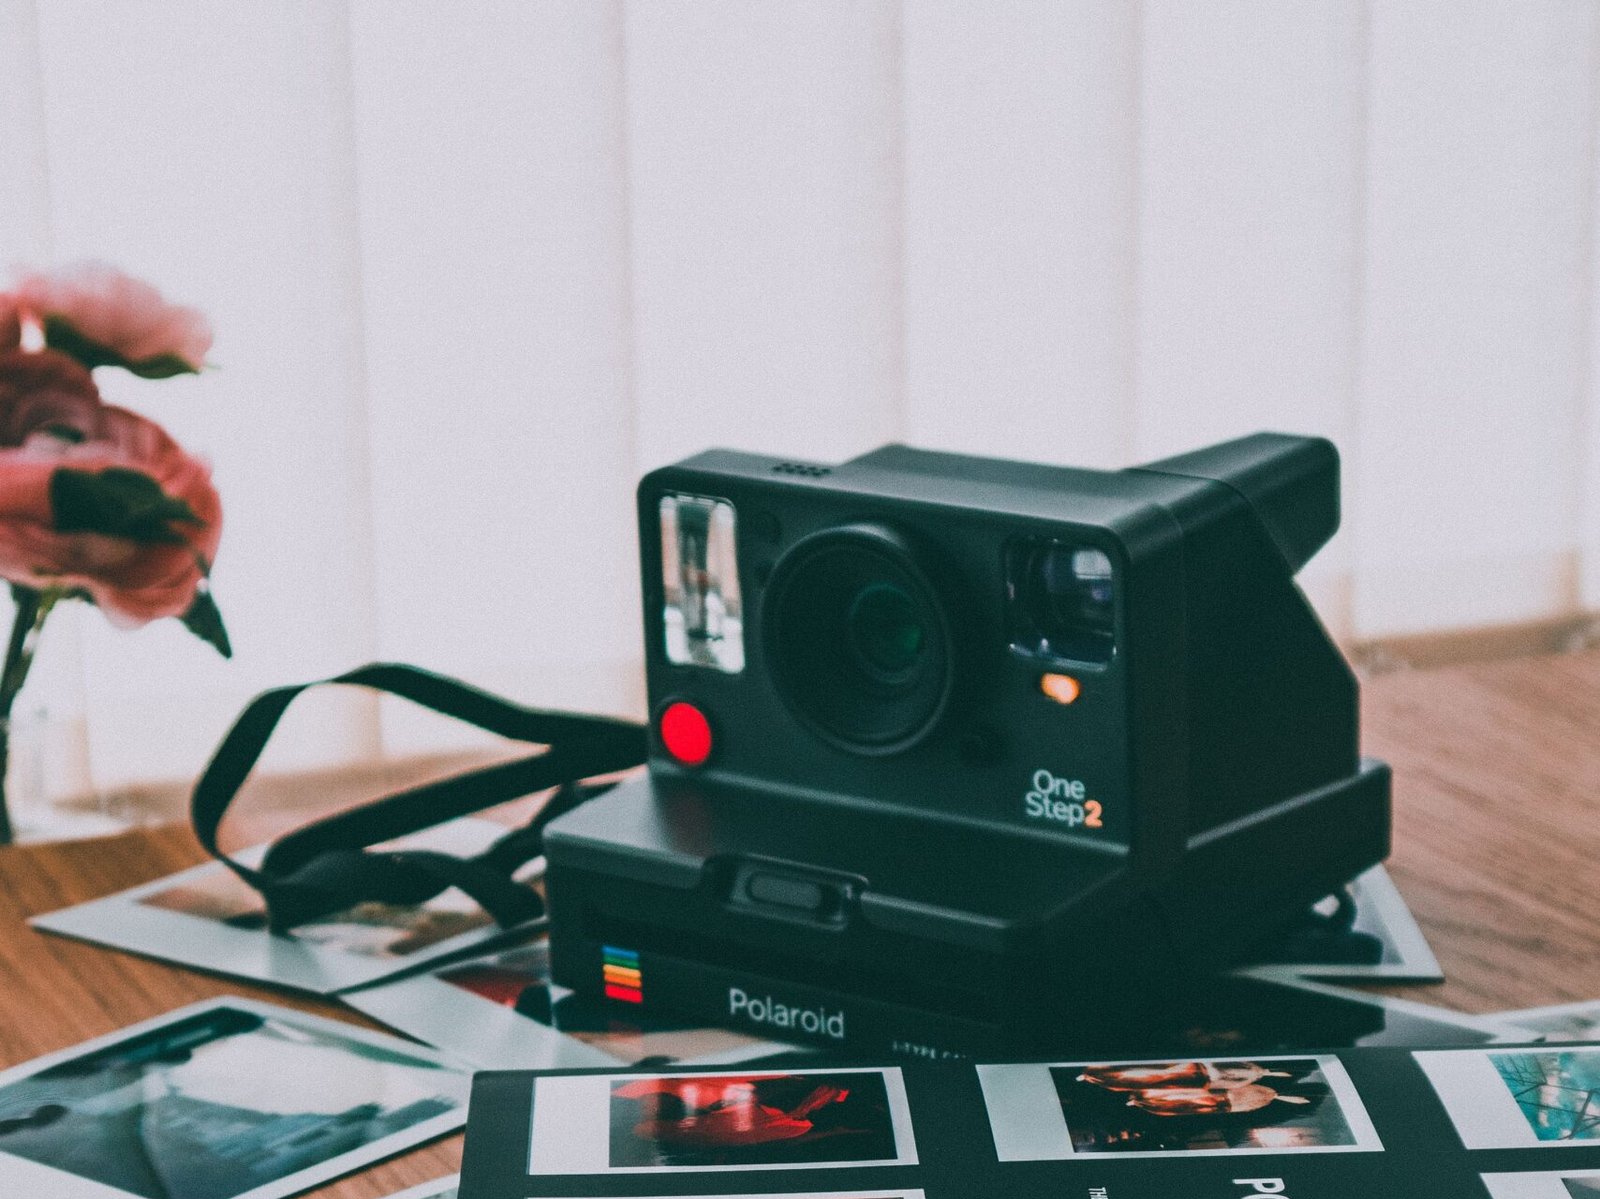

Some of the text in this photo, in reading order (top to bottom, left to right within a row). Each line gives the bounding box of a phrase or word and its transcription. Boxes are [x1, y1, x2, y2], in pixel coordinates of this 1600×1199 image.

[1033, 769, 1085, 800] One
[1025, 791, 1103, 828] Step2
[729, 987, 844, 1038] Polaroid
